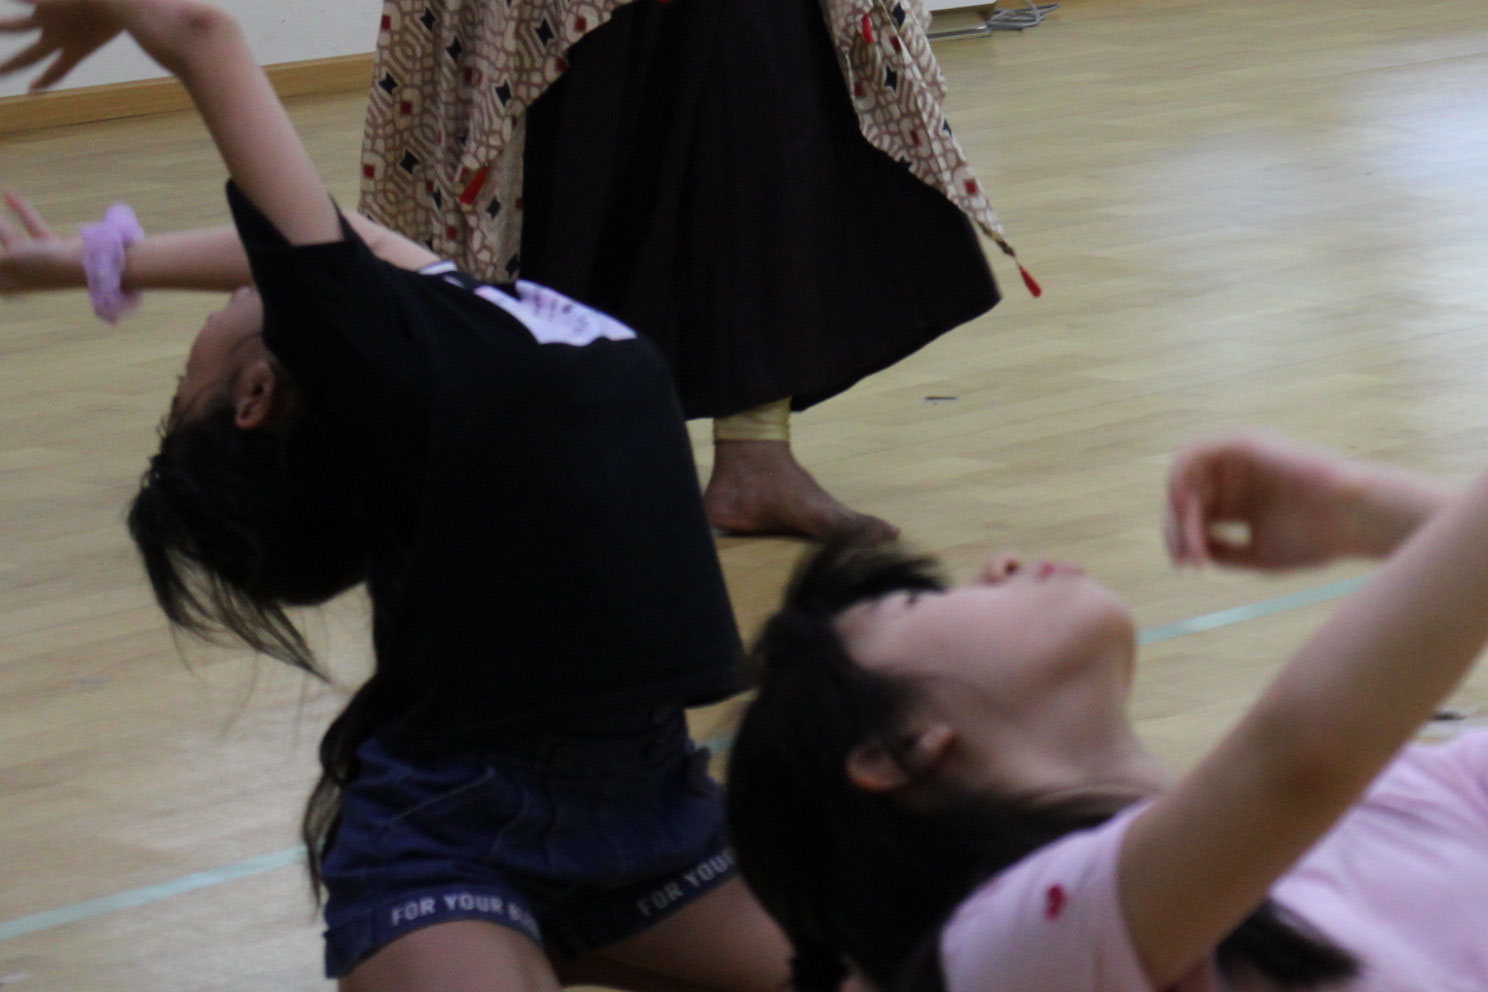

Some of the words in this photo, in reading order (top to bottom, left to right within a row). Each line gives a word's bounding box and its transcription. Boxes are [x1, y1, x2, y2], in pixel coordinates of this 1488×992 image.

[391, 896, 435, 926] FOR
[443, 893, 504, 914] YOUR
[638, 881, 684, 917] FOR
